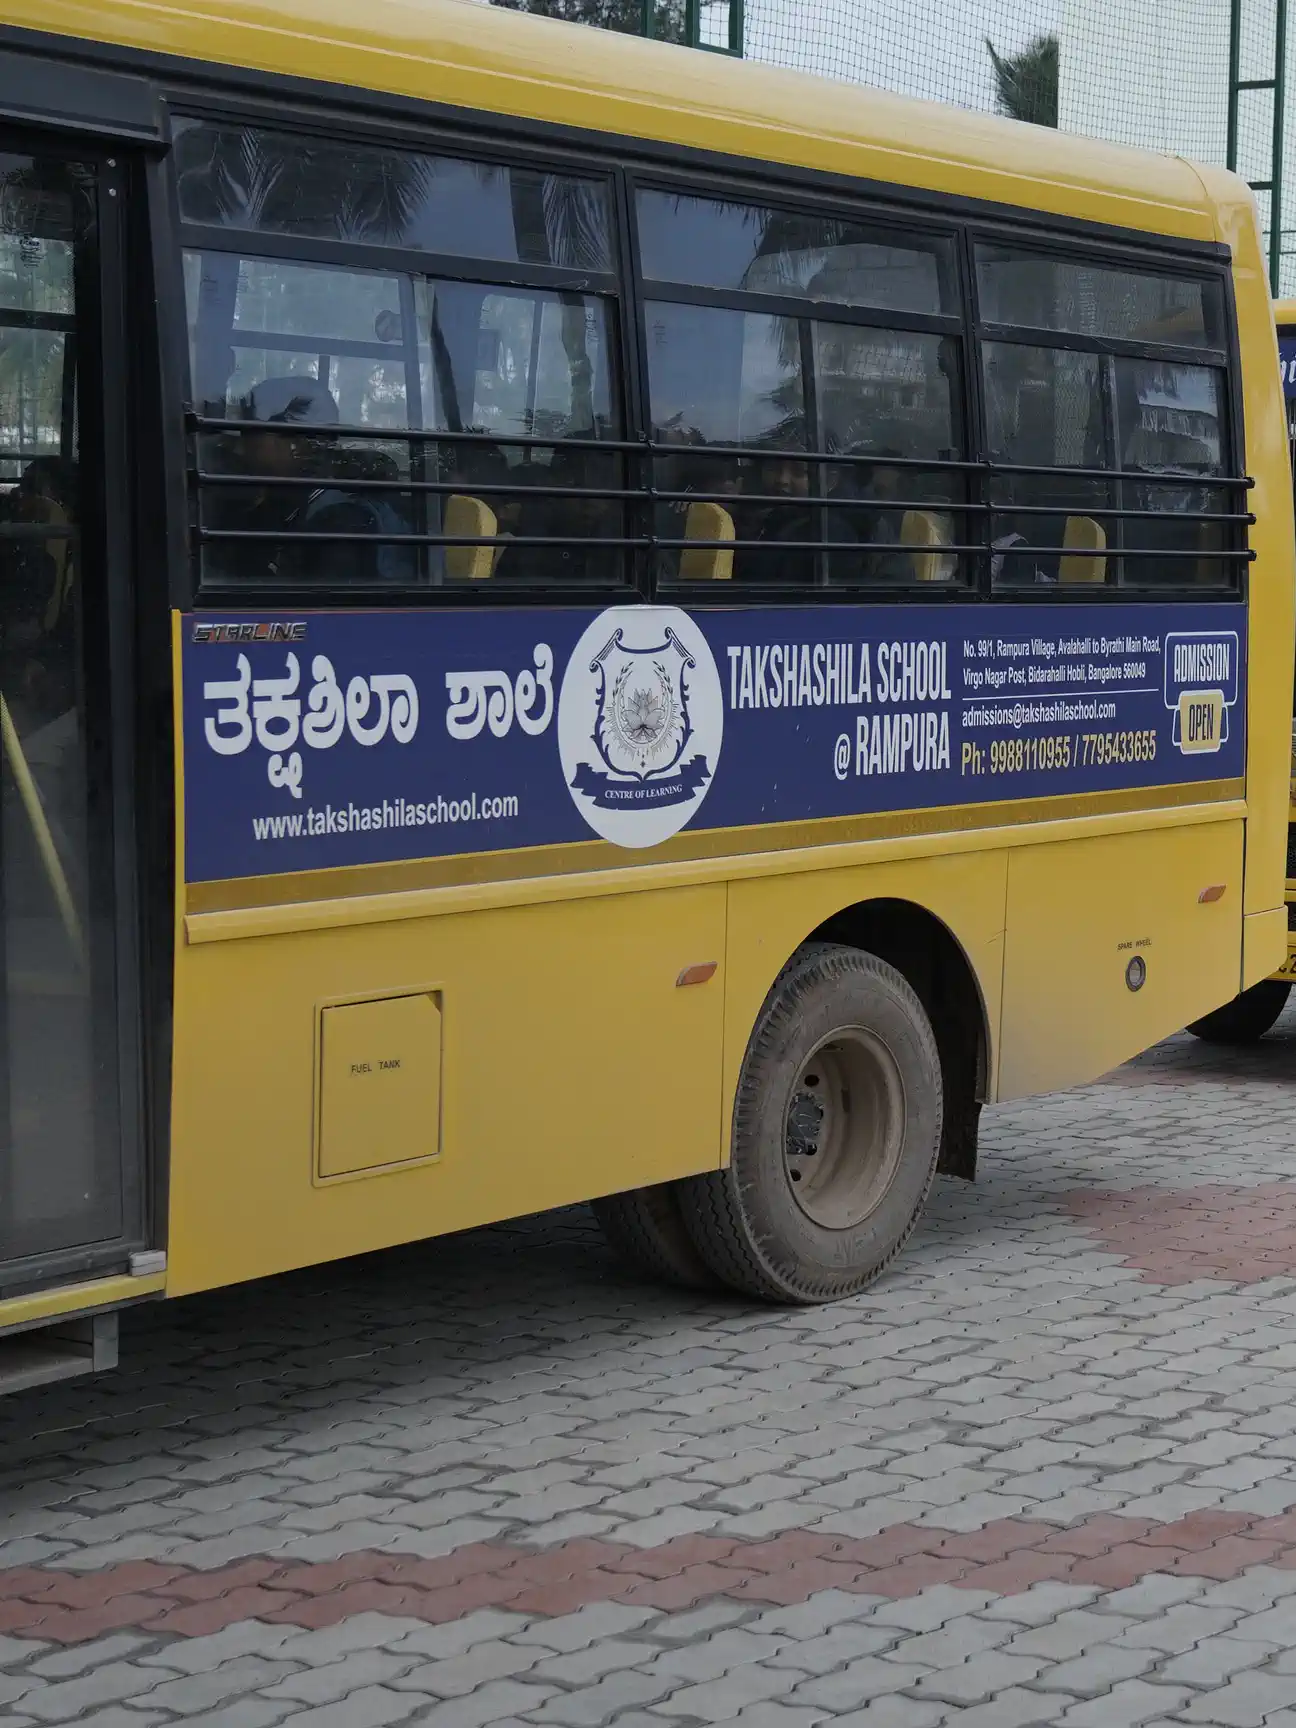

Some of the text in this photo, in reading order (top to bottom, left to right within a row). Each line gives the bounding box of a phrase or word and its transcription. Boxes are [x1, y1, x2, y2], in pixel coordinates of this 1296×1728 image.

[192, 621, 307, 643] STARLINE
[963, 640, 976, 658] No.
[997, 639, 1030, 660] Rampura
[1031, 638, 1057, 660] Village,
[1092, 638, 1099, 654] to
[1101, 636, 1125, 657] Byrathi
[1125, 636, 1142, 653] Main
[1142, 636, 1161, 655] Road,
[728, 640, 951, 710] TAKSHASHILA SCHOOL
[963, 662, 1146, 690] Virgo Nagar Post, Bidarahalli Hobli, Bangalore 560049
[1174, 643, 1230, 683] ADMISSION
[203, 643, 554, 799] ತಕ್ಷಶಿಲಾ ಶಾಲೆ
[962, 702, 1116, 729] admissions@takshashilaschool.com
[1188, 703, 1214, 742] OPEN
[834, 711, 951, 780] @ RAMPURA
[961, 742, 986, 776] Ph:
[990, 735, 1071, 774] 9988110955
[1082, 729, 1157, 767] 7795433655
[604, 784, 683, 799] CENTRE OF LEARNING
[253, 792, 519, 840] www.takshashilaschool.com
[351, 1059, 401, 1074] FUEL TANK
